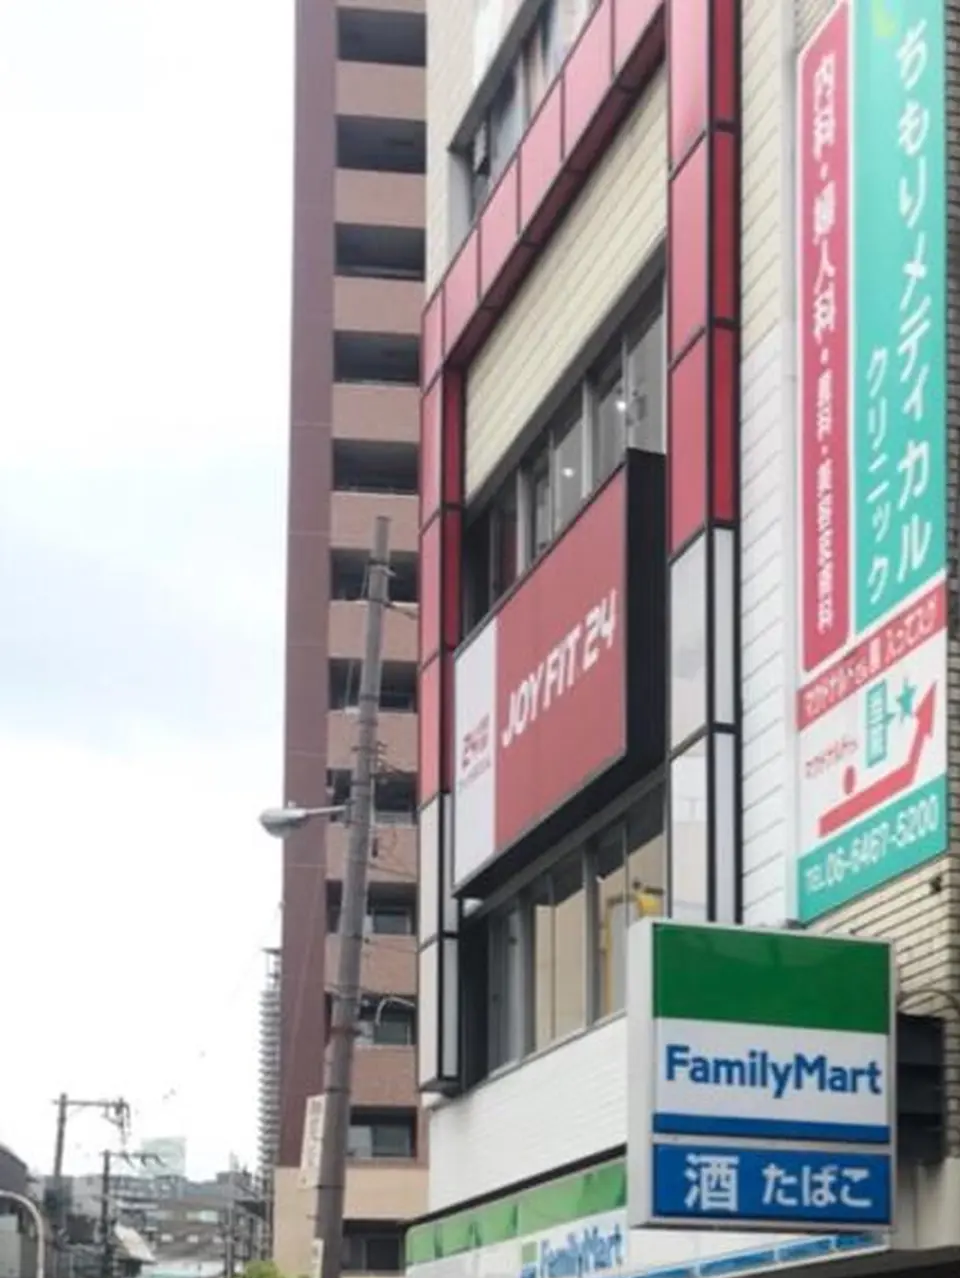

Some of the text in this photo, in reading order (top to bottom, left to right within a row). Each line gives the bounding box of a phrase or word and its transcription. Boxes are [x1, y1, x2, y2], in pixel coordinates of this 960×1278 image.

[896, 18, 932, 584] ちもりメディカル
[866, 345, 890, 606] クリニック
[665, 1043, 883, 1099] FamilyMart
[684, 1152, 873, 1213] 酒 たばこ
